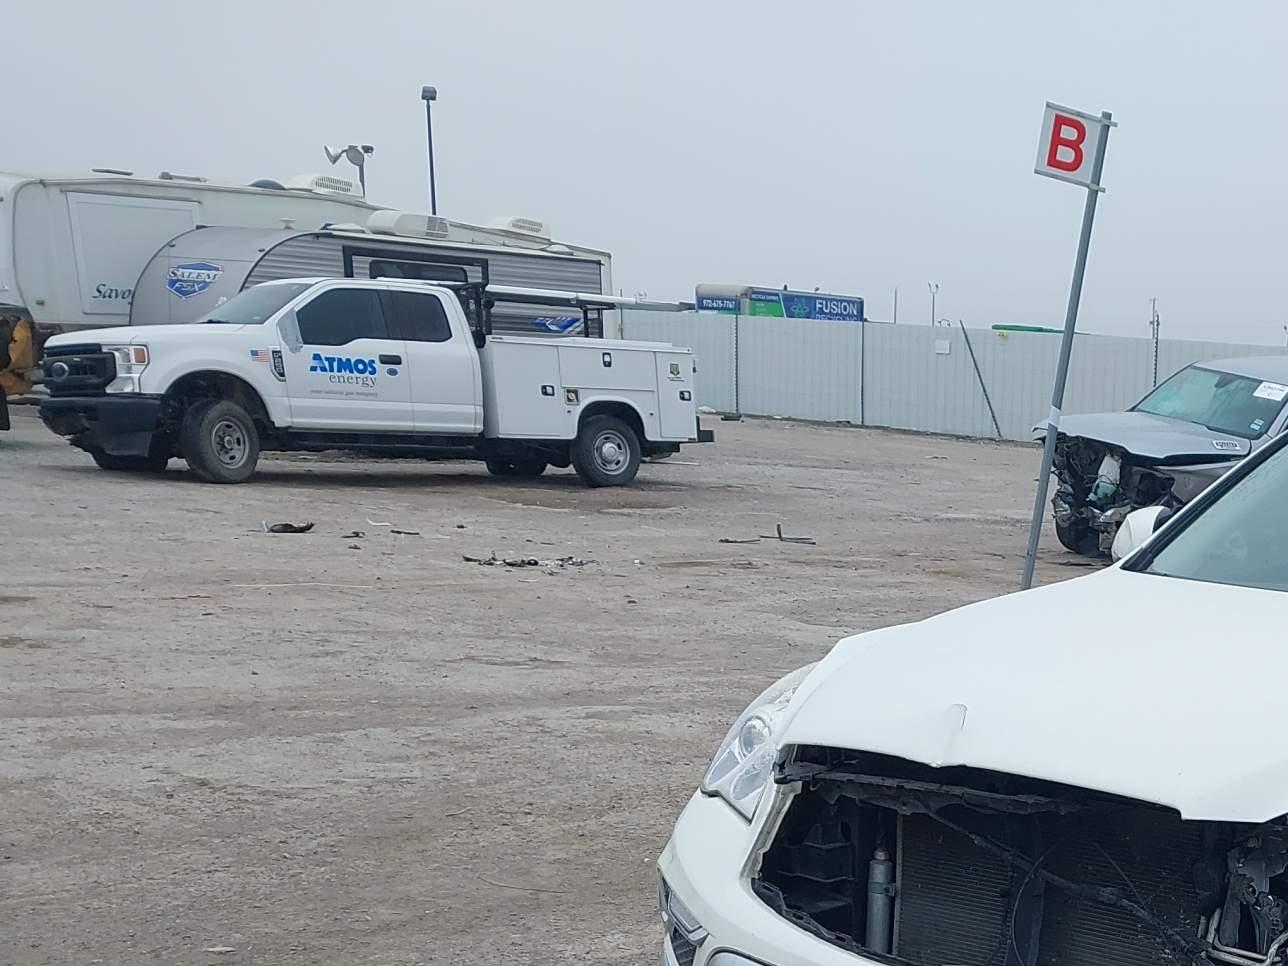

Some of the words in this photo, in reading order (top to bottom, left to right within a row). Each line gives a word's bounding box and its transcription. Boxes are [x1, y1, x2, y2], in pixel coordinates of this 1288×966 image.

[1046, 113, 1087, 172] B
[168, 268, 219, 281] SALEM
[815, 300, 858, 316] FUSION
[310, 353, 377, 375] ATMOS
[329, 374, 377, 388] energy
